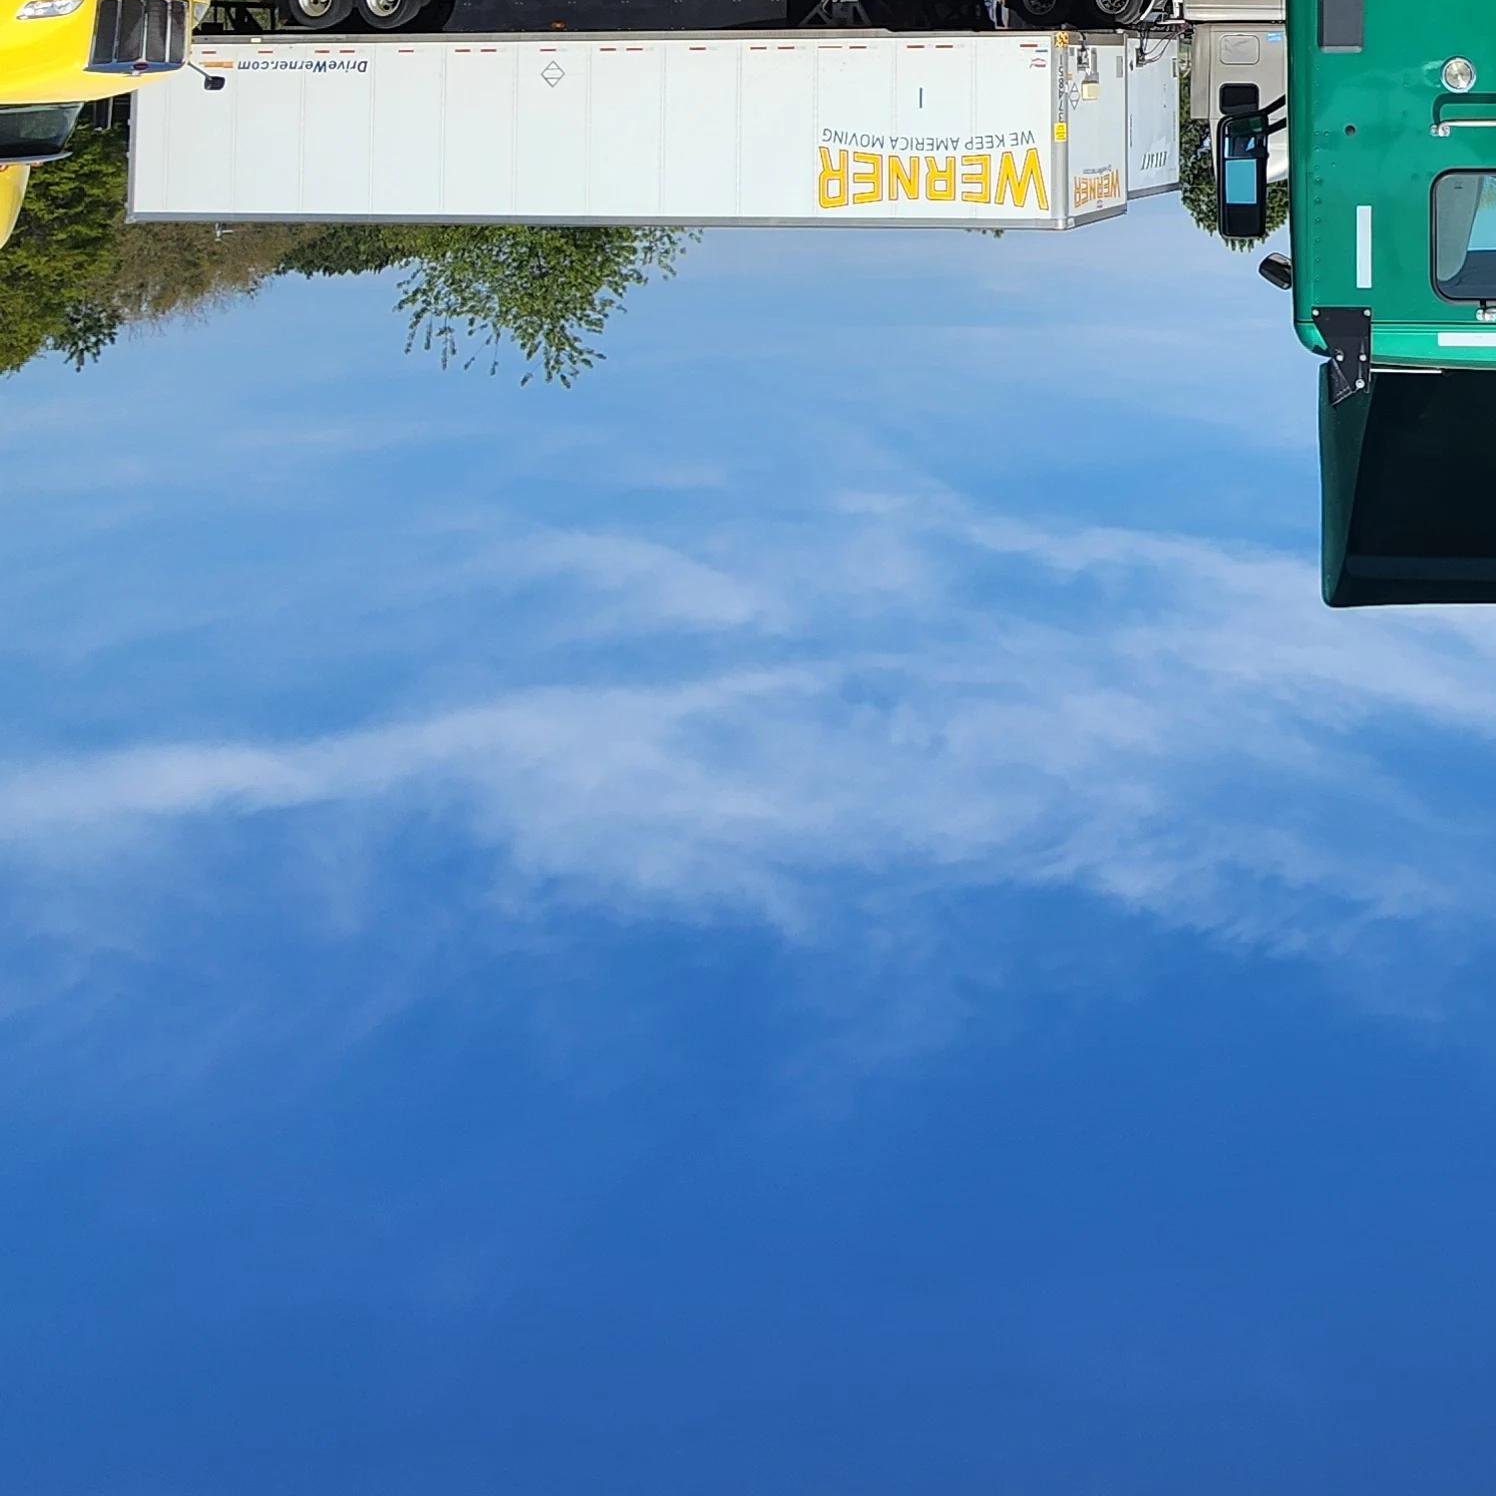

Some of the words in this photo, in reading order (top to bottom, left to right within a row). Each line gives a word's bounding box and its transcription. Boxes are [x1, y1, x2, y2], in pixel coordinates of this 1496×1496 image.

[236, 58, 369, 75] DriveWerner.com
[818, 127, 885, 150] MOVING
[889, 135, 961, 152] AMERICA
[964, 133, 1006, 151] KEEP
[1008, 129, 1035, 148] WE
[817, 146, 1050, 211] WERNER
[1073, 168, 1121, 209] WERNER
